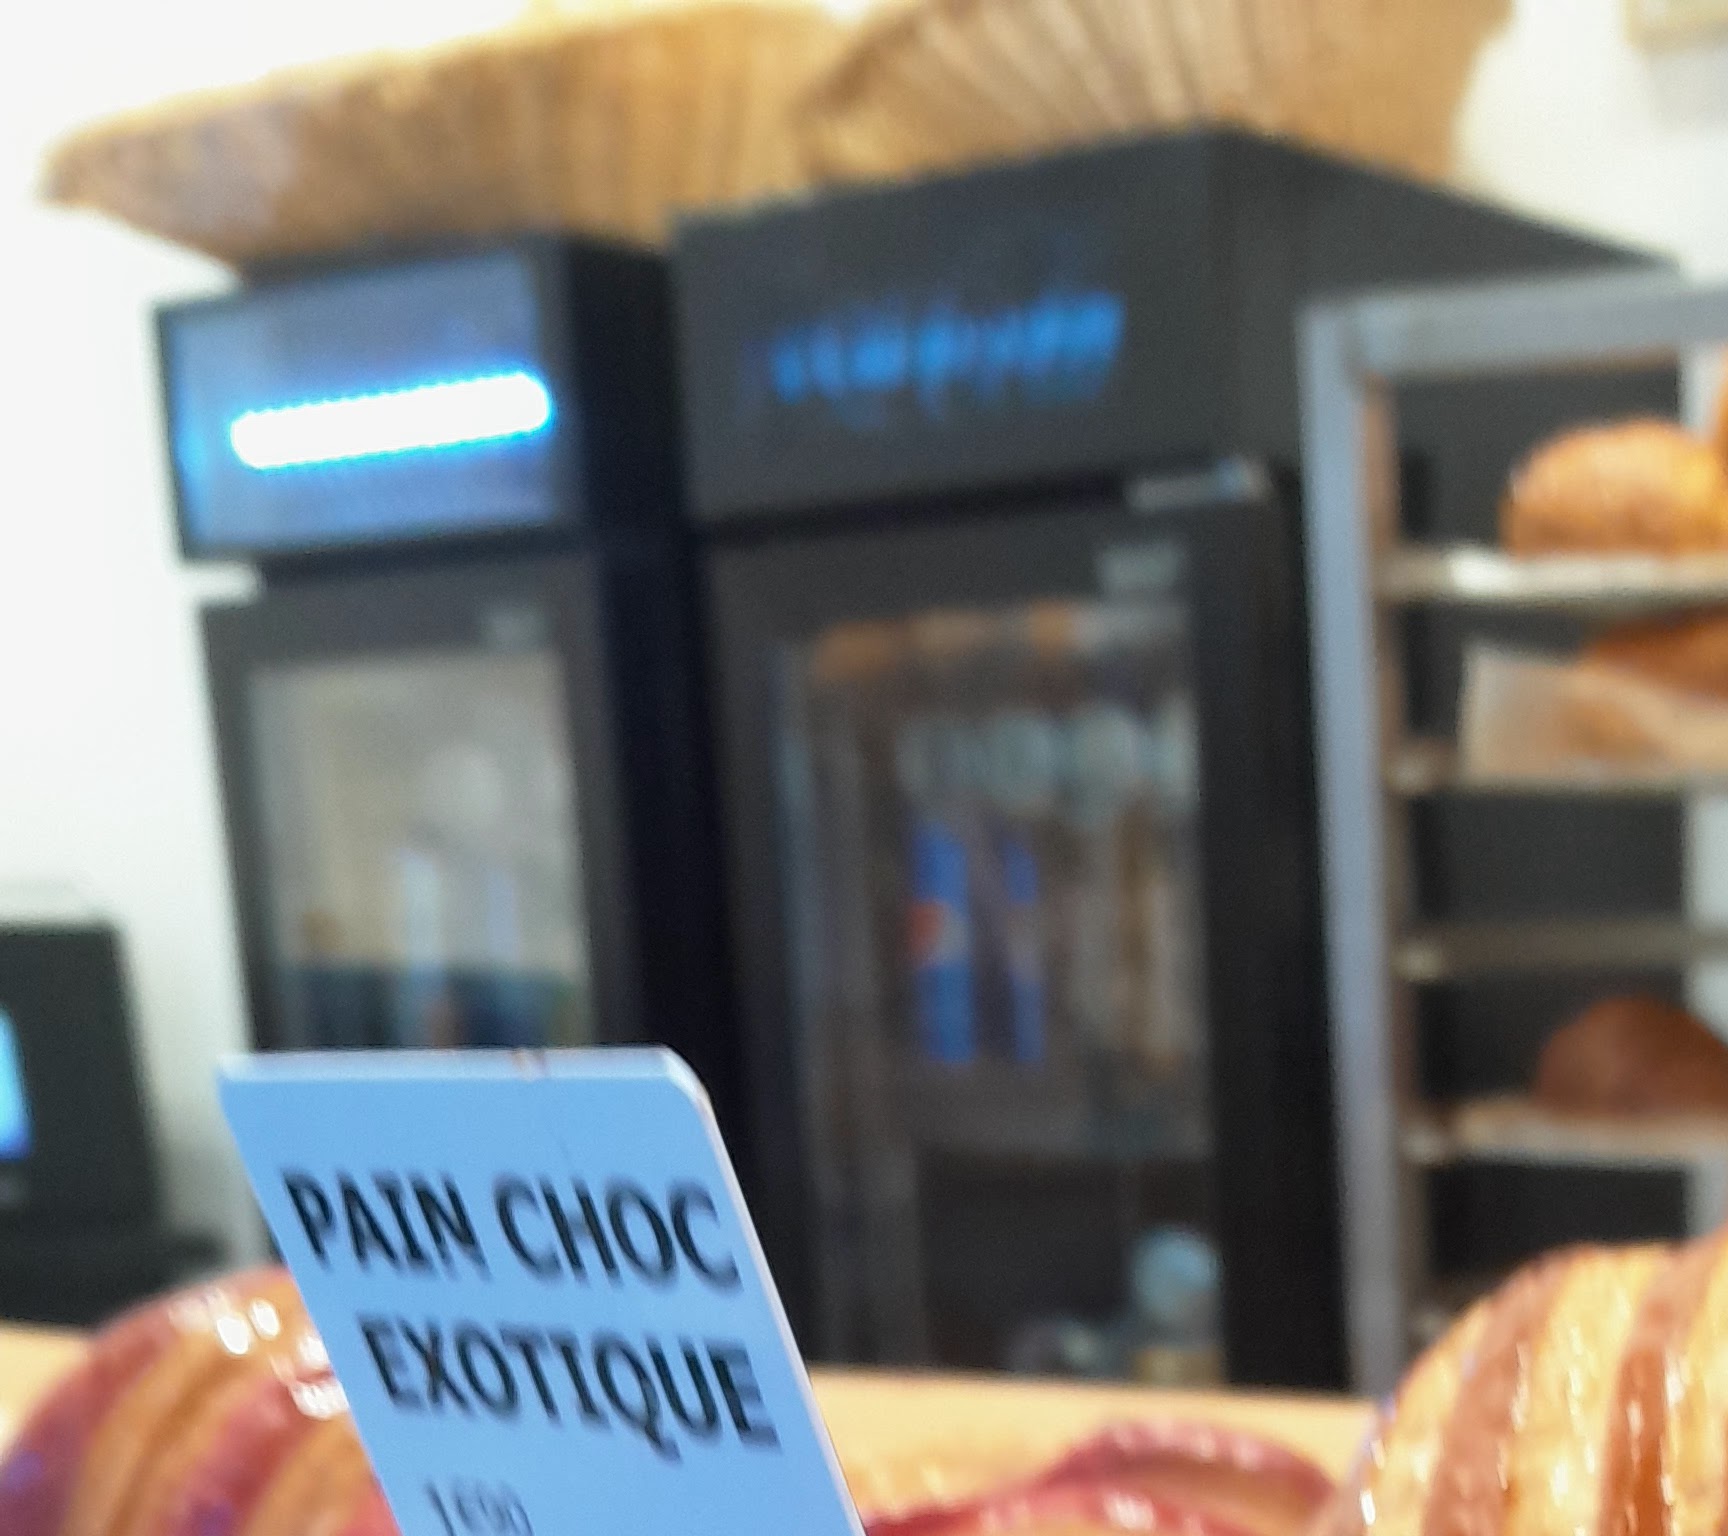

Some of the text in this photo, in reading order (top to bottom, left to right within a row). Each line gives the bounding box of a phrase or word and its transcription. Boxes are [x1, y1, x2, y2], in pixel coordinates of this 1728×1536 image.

[283, 1171, 743, 1292] PAIN CHOC
[357, 1314, 781, 1463] EXOTIQUE
